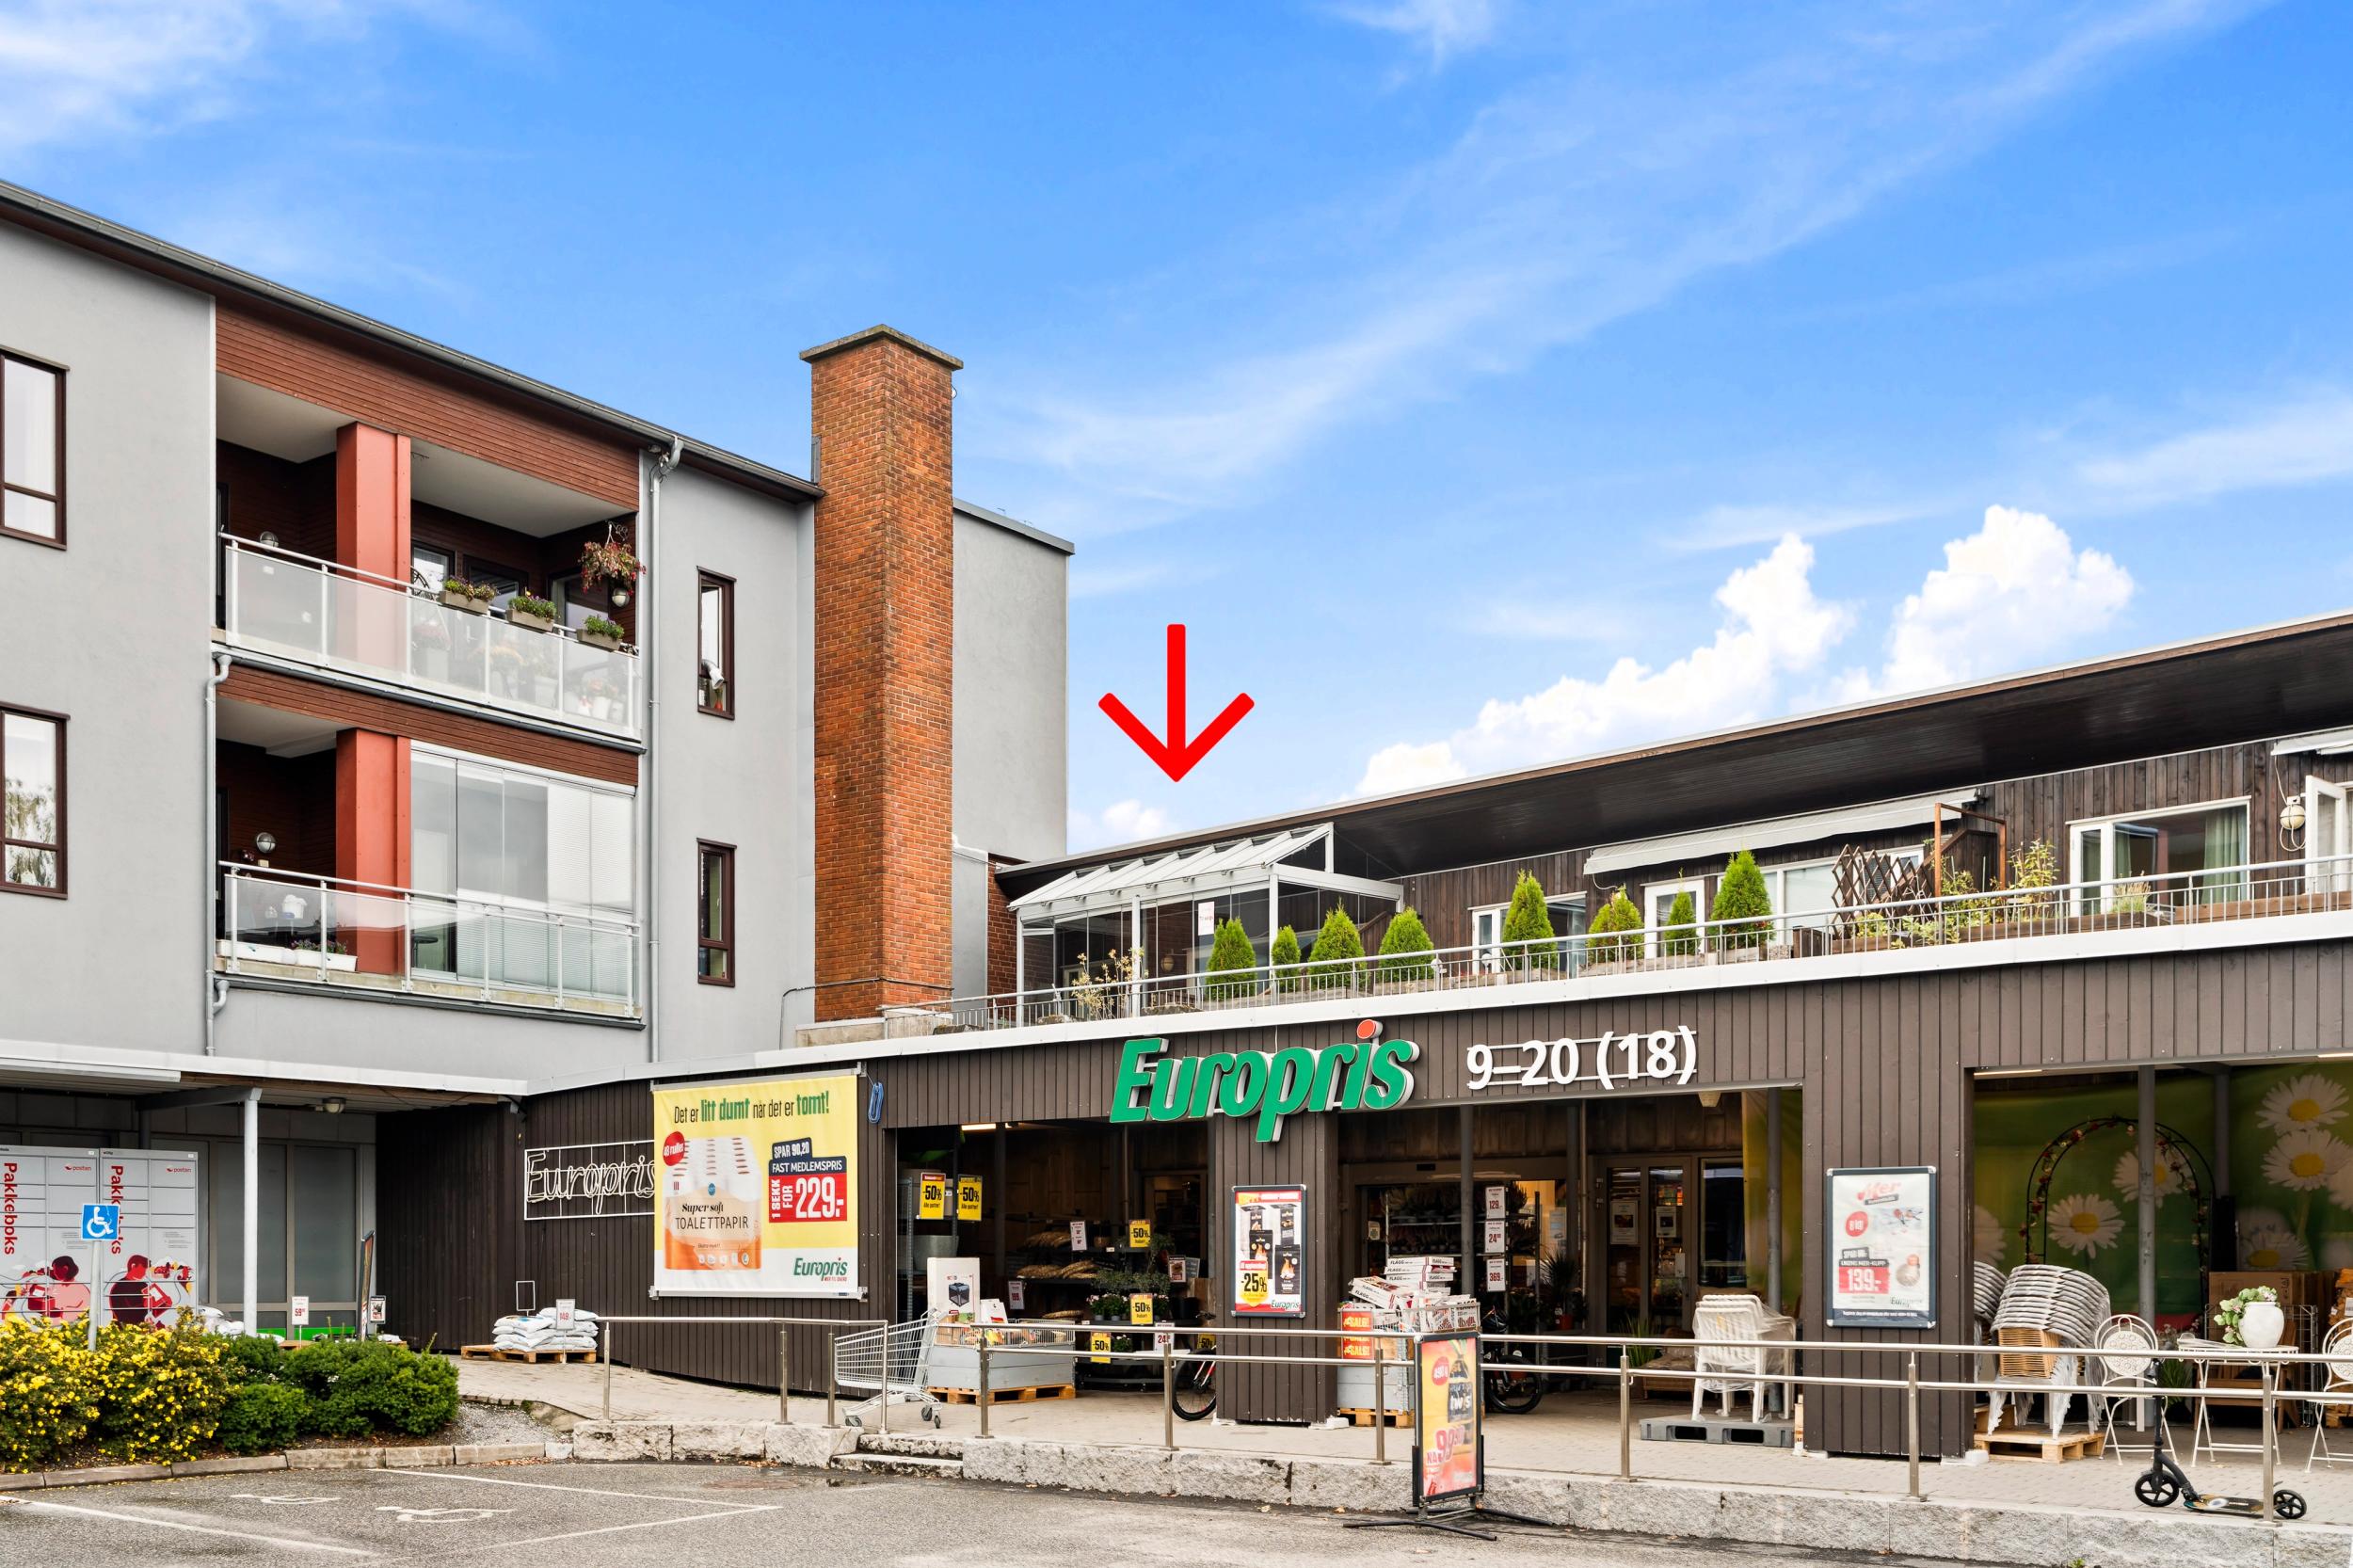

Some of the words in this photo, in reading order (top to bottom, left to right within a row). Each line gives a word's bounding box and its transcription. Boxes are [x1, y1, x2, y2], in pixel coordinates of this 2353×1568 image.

[1596, 1025, 1697, 1090] (18)
[1109, 1018, 1420, 1143] Europris
[674, 1106, 688, 1124] Det
[690, 1108, 699, 1123] er
[700, 1099, 716, 1122] litt
[719, 1097, 751, 1121] dumt
[753, 1100, 767, 1118] når
[768, 1100, 782, 1117] det
[784, 1100, 795, 1115] er
[796, 1091, 829, 1115] tomt!
[774, 1144, 791, 1159] SPAR
[772, 1162, 790, 1174] FAST
[791, 1160, 842, 1173] MEDLEMSPRIS
[771, 1178, 781, 1211] SEKK
[782, 1185, 792, 1208] FOR
[922, 1185, 942, 1201] -50%
[960, 1187, 980, 1202] -50%
[4, 1162, 18, 1255] Pakkeboks
[111, 1165, 124, 1255] Pakkks
[681, 1203, 709, 1215] Super
[710, 1202, 724, 1214] soft
[675, 1216, 749, 1229] TOALETTPAPIR
[1131, 1227, 1149, 1239] -50%
[793, 1256, 848, 1281] Europris
[1241, 1272, 1268, 1292] -25%
[1132, 1302, 1151, 1313] -50%
